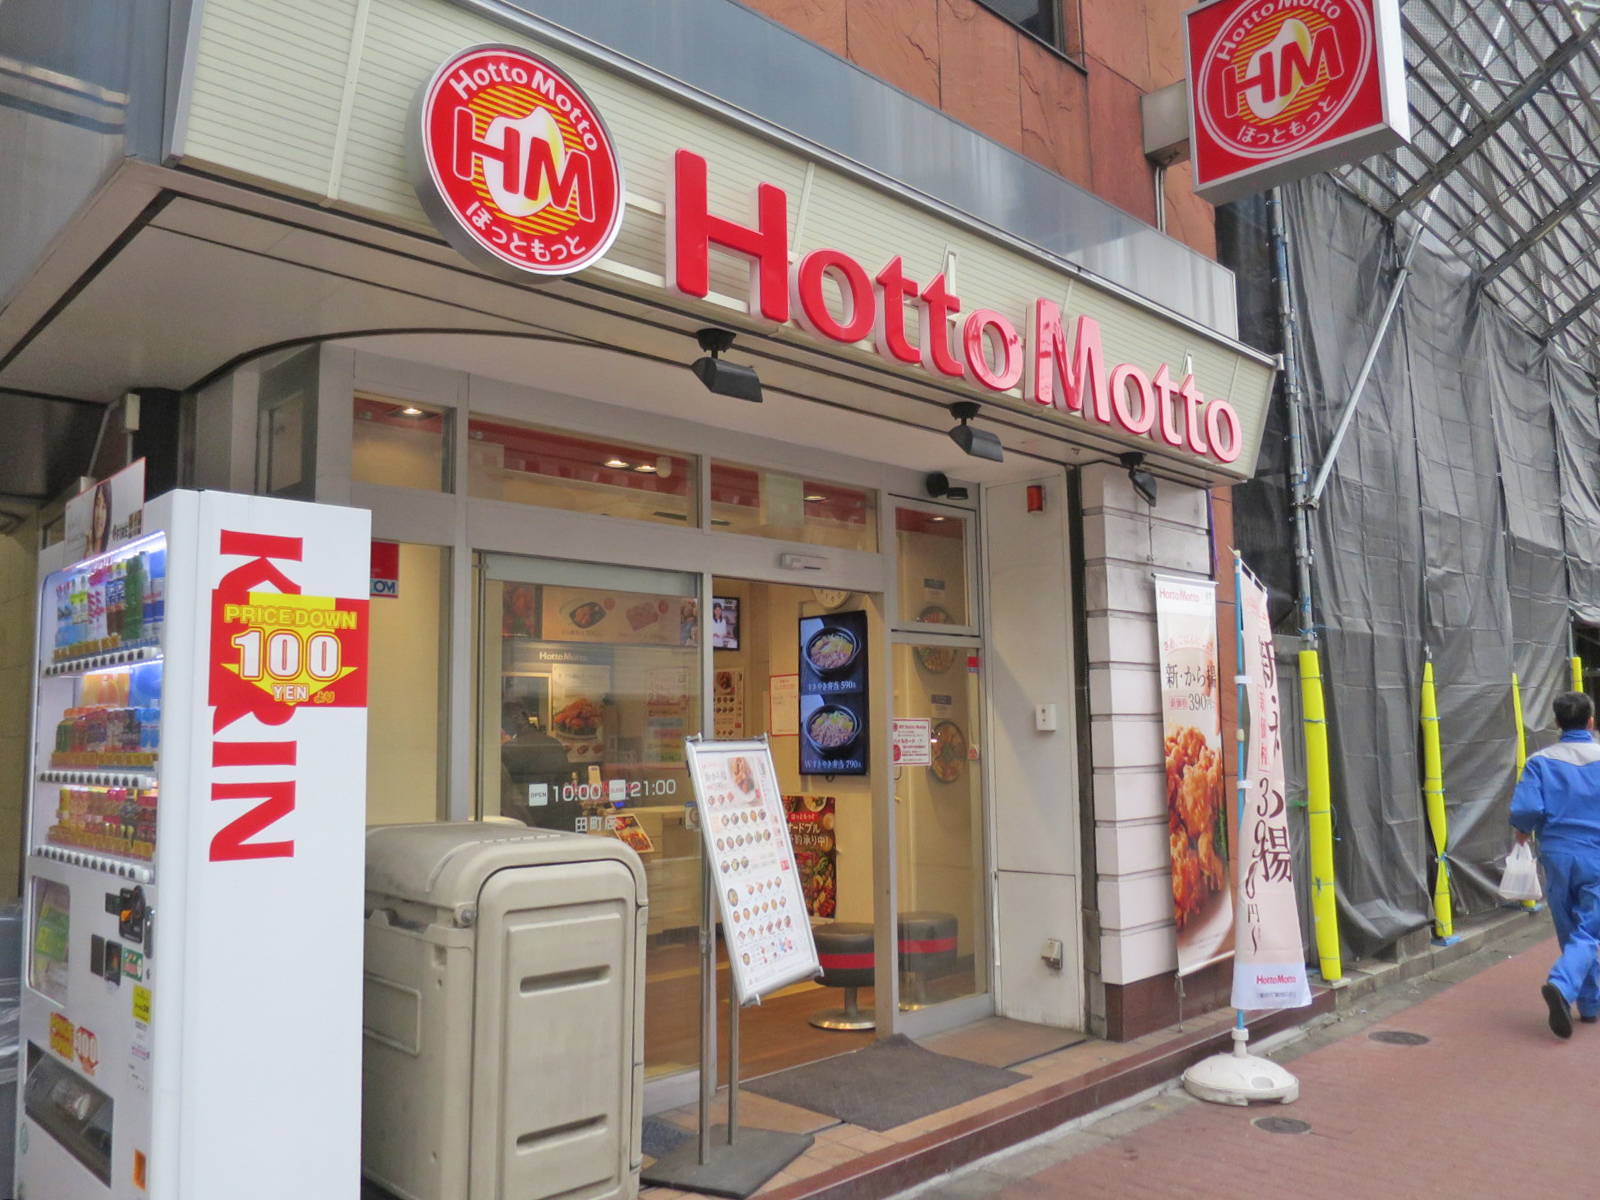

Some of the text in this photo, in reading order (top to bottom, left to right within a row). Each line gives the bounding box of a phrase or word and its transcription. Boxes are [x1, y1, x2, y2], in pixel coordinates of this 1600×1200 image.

[1216, 2, 1275, 60] Hotto
[1222, 25, 1344, 118] HM
[450, 62, 598, 151] Hotto Motto
[1237, 95, 1337, 145] ほっともっと
[453, 106, 595, 223] HM
[466, 201, 586, 262] ほっともっと
[668, 148, 1243, 464] Hotto Motto
[224, 604, 357, 630] PRICE DOWN
[1159, 587, 1179, 600] Hotto
[1179, 589, 1200, 602] Motto
[231, 627, 342, 682] 100
[539, 651, 563, 661] Hotto
[209, 529, 303, 861] KRIN
[272, 683, 309, 702] YEN
[552, 783, 601, 803] 10:00
[630, 779, 677, 798] 21:00
[1256, 974, 1297, 984] Hotto Motto
